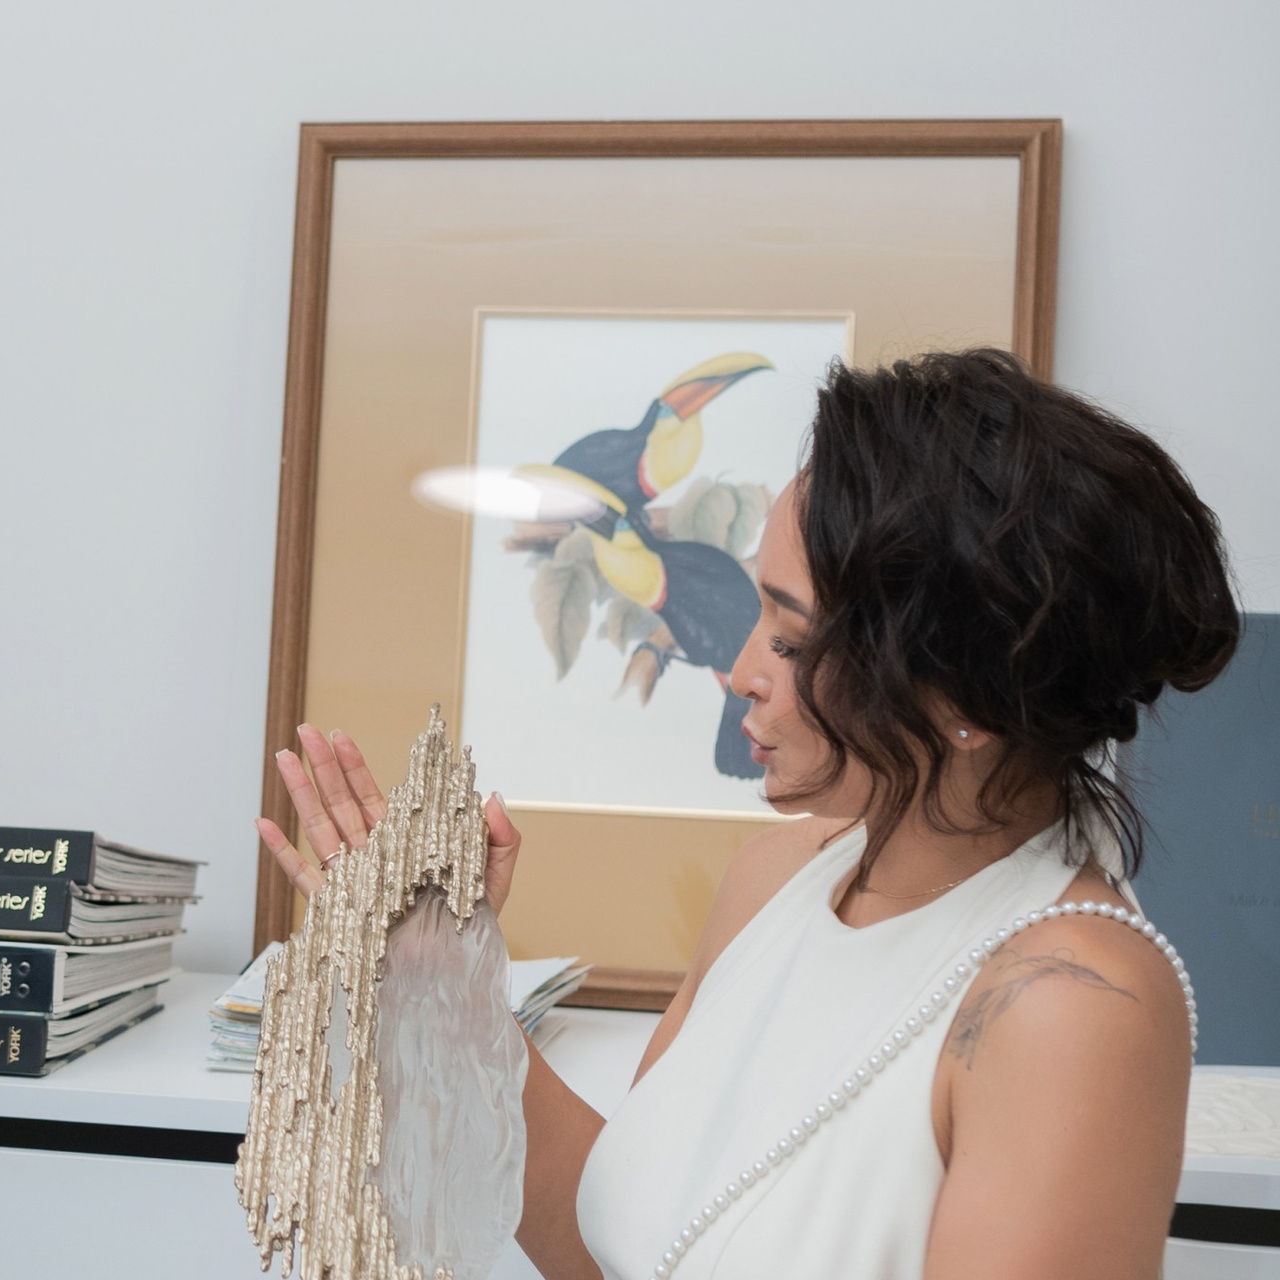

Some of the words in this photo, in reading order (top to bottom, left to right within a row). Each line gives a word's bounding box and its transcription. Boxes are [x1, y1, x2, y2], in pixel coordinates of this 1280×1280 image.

[3, 847, 52, 864] series
[53, 838, 69, 874] YORK
[32, 885, 47, 920] YORK
[9, 1026, 21, 1063] YORK
